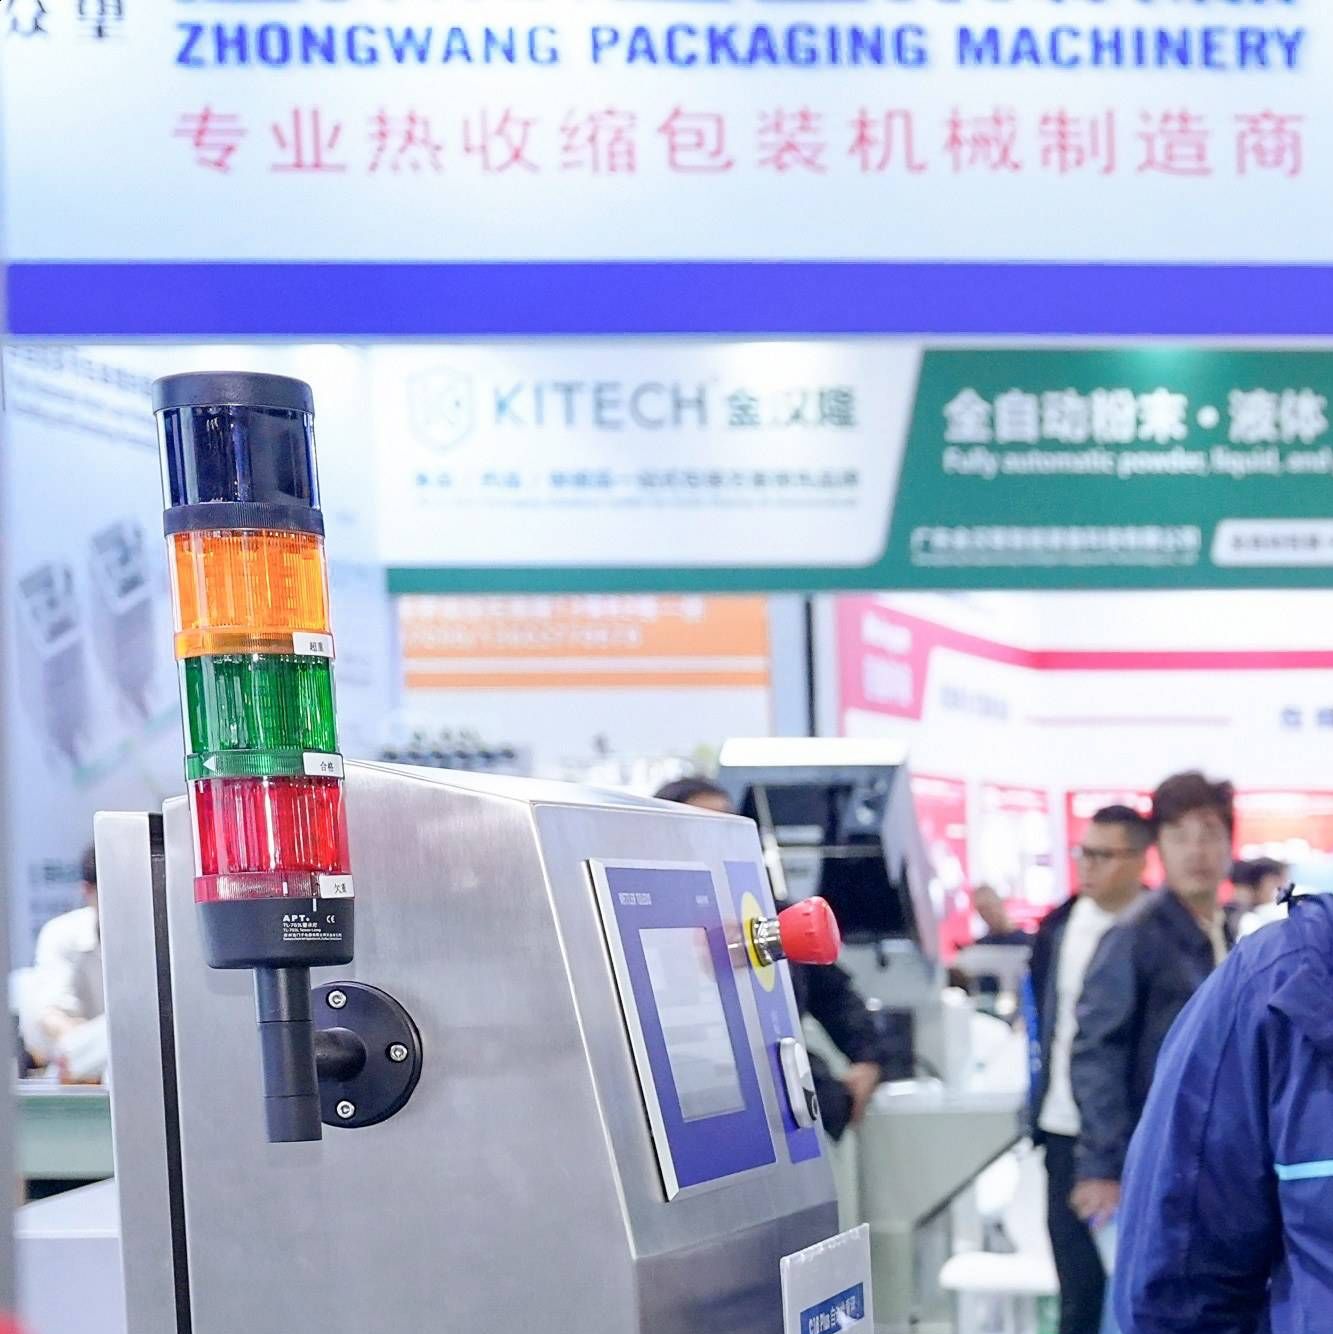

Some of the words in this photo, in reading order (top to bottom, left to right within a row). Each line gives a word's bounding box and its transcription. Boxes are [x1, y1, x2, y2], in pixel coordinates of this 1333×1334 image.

[175, 23, 561, 67] ZHONGWANG
[589, 23, 928, 68] PACKAGING
[957, 24, 1307, 68] MACHINERY
[171, 105, 1307, 177] 专业热收缩包装机械制造商
[495, 380, 709, 430] KITECH
[320, 760, 335, 772] 合格
